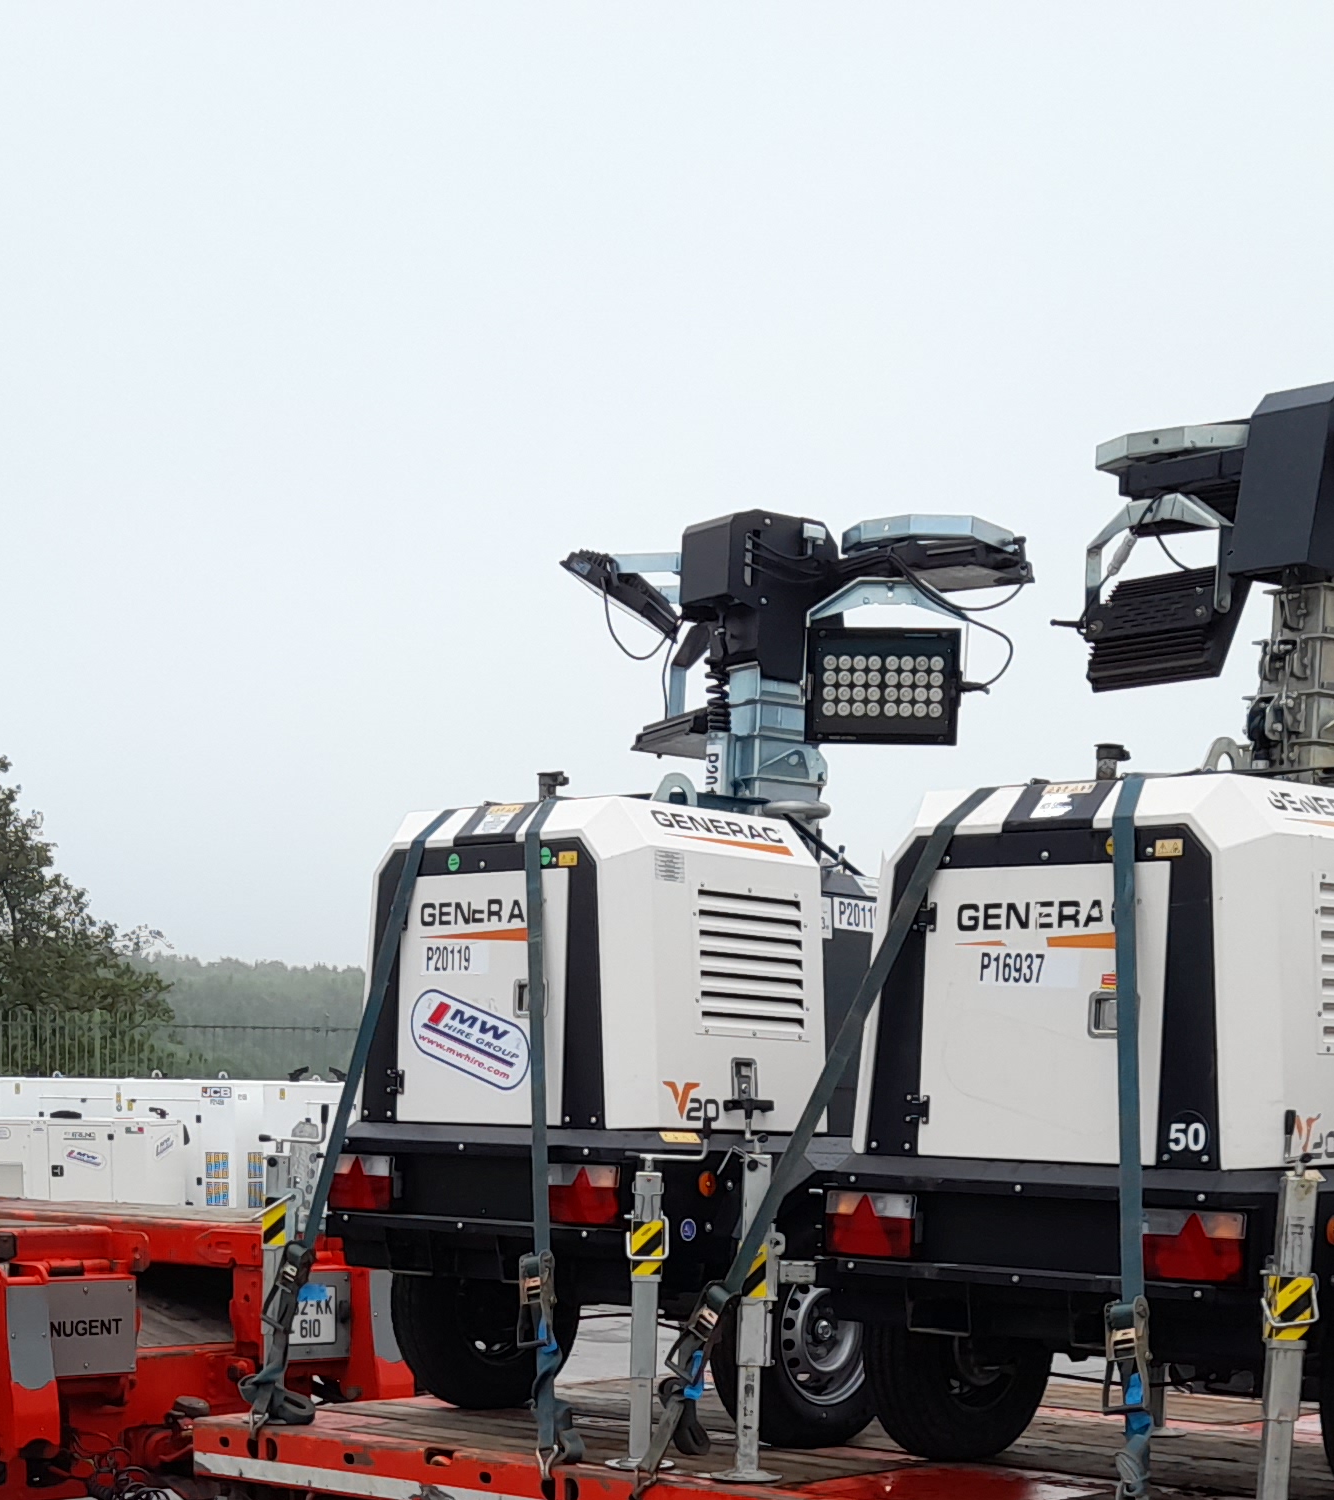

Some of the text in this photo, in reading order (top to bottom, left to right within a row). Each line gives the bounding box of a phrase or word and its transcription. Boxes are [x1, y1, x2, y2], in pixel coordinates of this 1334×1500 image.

[649, 809, 785, 844] GENERAC
[838, 900, 878, 930] P2011
[957, 900, 1116, 932] GENERA
[425, 945, 472, 972] P20119
[979, 952, 1045, 984] P16937
[441, 1021, 521, 1060] HIRE GROUP
[450, 1008, 511, 1042] MW
[417, 1033, 511, 1081] www.mwhire.com
[202, 1087, 231, 1097] JCB
[662, 1080, 720, 1122] V20
[1168, 1122, 1206, 1151] 50
[50, 1318, 123, 1338] NUGENT
[300, 1318, 321, 1338] 610
